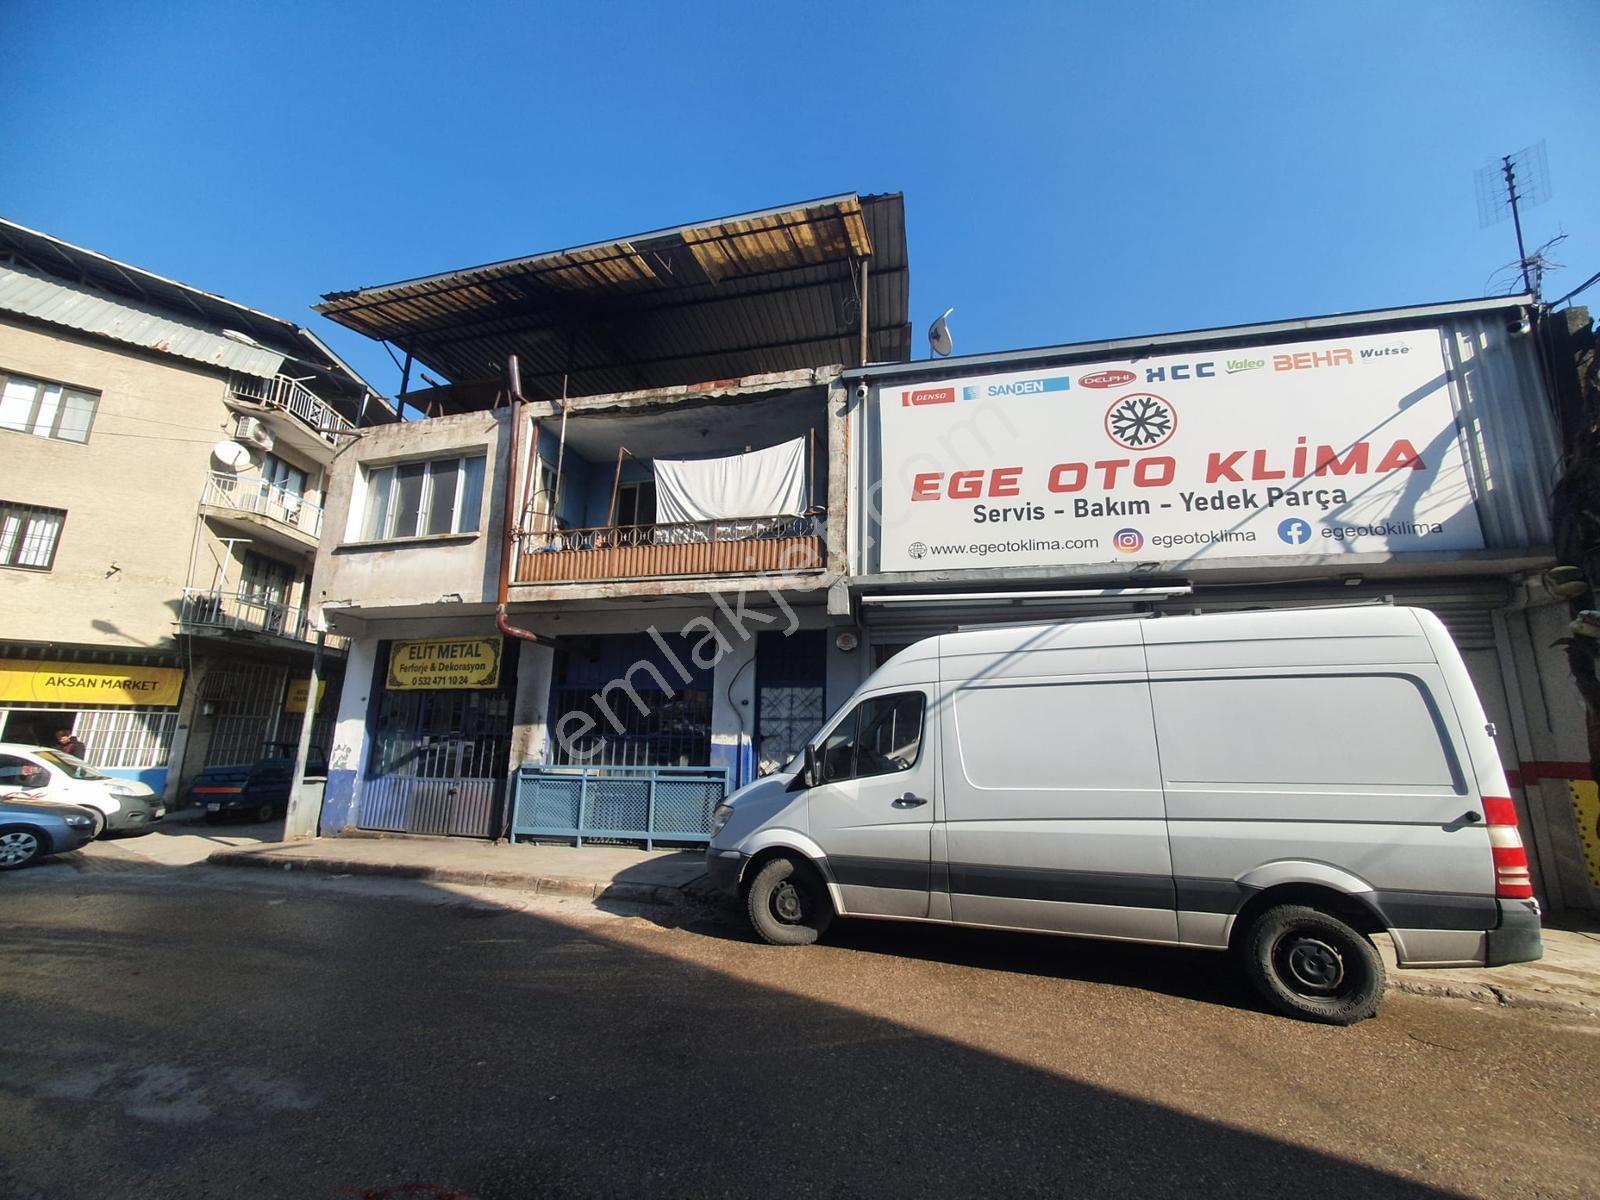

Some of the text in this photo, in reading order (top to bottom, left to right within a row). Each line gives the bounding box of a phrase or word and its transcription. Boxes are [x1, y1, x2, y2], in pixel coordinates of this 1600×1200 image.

[1273, 349, 1353, 371] BEHR
[1360, 347, 1409, 358] Wutse
[1146, 362, 1215, 382] HCC
[1226, 359, 1265, 370] Valeo
[1084, 375, 1129, 384] DELPHI
[988, 381, 1044, 396] SANDEN
[916, 392, 947, 401] DENSO
[911, 436, 1427, 502] EGE OTO KLİMA
[973, 501, 1045, 523] Servis
[1074, 496, 1150, 518] Bakım
[1180, 489, 1259, 512] Yedek
[1266, 486, 1347, 510] Parça
[1152, 529, 1256, 548] egeotoklima
[1321, 522, 1443, 541] egeotokilima
[930, 538, 1099, 556] www.egeotoklima.com
[437, 643, 481, 658] METAL
[400, 662, 486, 674] Ferforje & Dekorasyon
[45, 676, 159, 690] AKSAN MARKET
[432, 677, 446, 685] 471
